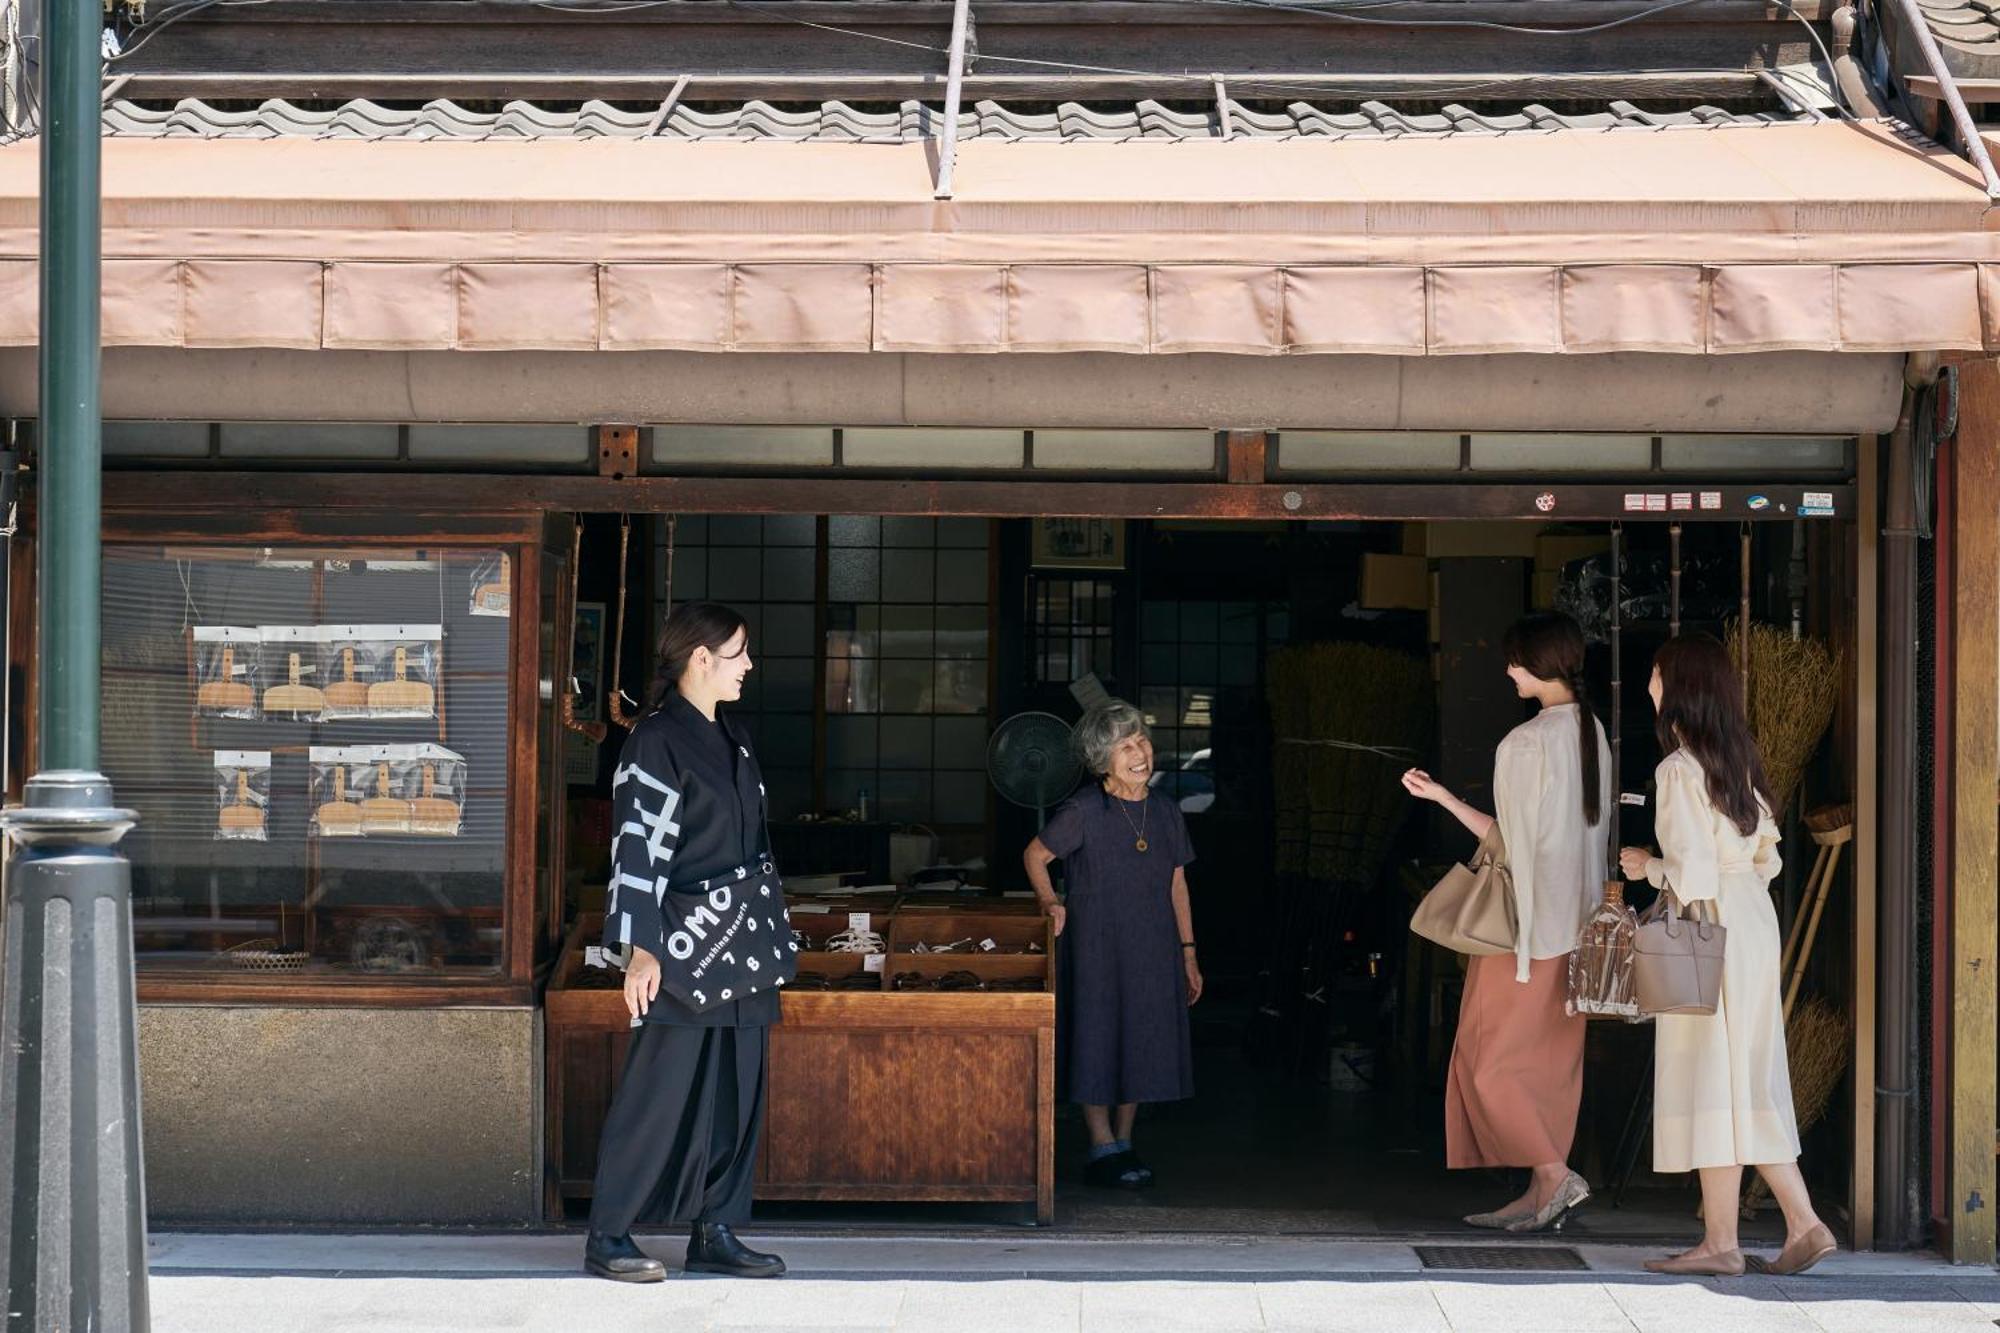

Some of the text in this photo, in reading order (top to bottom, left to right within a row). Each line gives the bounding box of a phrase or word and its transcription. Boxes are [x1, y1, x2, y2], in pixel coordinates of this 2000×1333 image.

[667, 886, 732, 960] OMO
[722, 951, 735, 965] 7
[746, 956, 760, 971] 8
[692, 967, 704, 979] by
[693, 990, 706, 1004] 3
